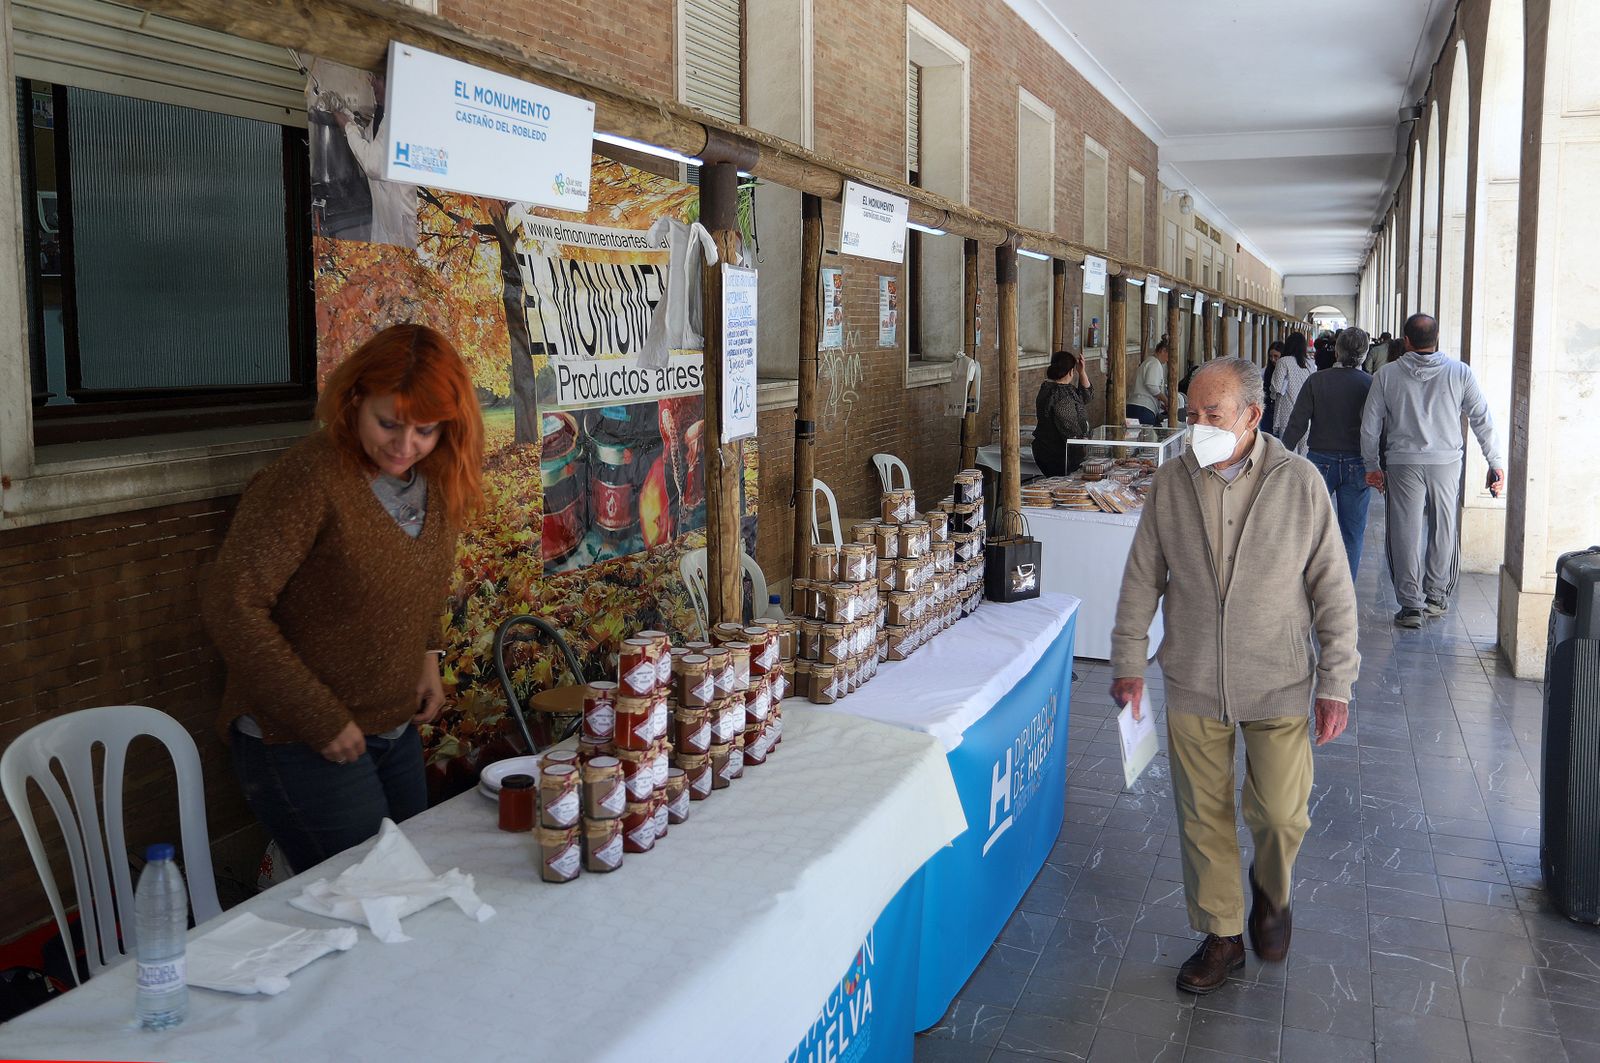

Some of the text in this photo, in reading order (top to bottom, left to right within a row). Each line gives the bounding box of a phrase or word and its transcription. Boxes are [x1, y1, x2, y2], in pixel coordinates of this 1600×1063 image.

[455, 80, 551, 120] EL MONUMENTO
[456, 111, 547, 142] CASTAÑO DEL ROBLEDO
[862, 196, 894, 213] EL MONUMENTO
[527, 222, 671, 249] www.elmonumentoartesal
[558, 364, 650, 400] Productos
[1014, 690, 1058, 767] DIPUTACIÓN
[1013, 762, 1025, 800] DE
[1028, 722, 1055, 781] HUELVA
